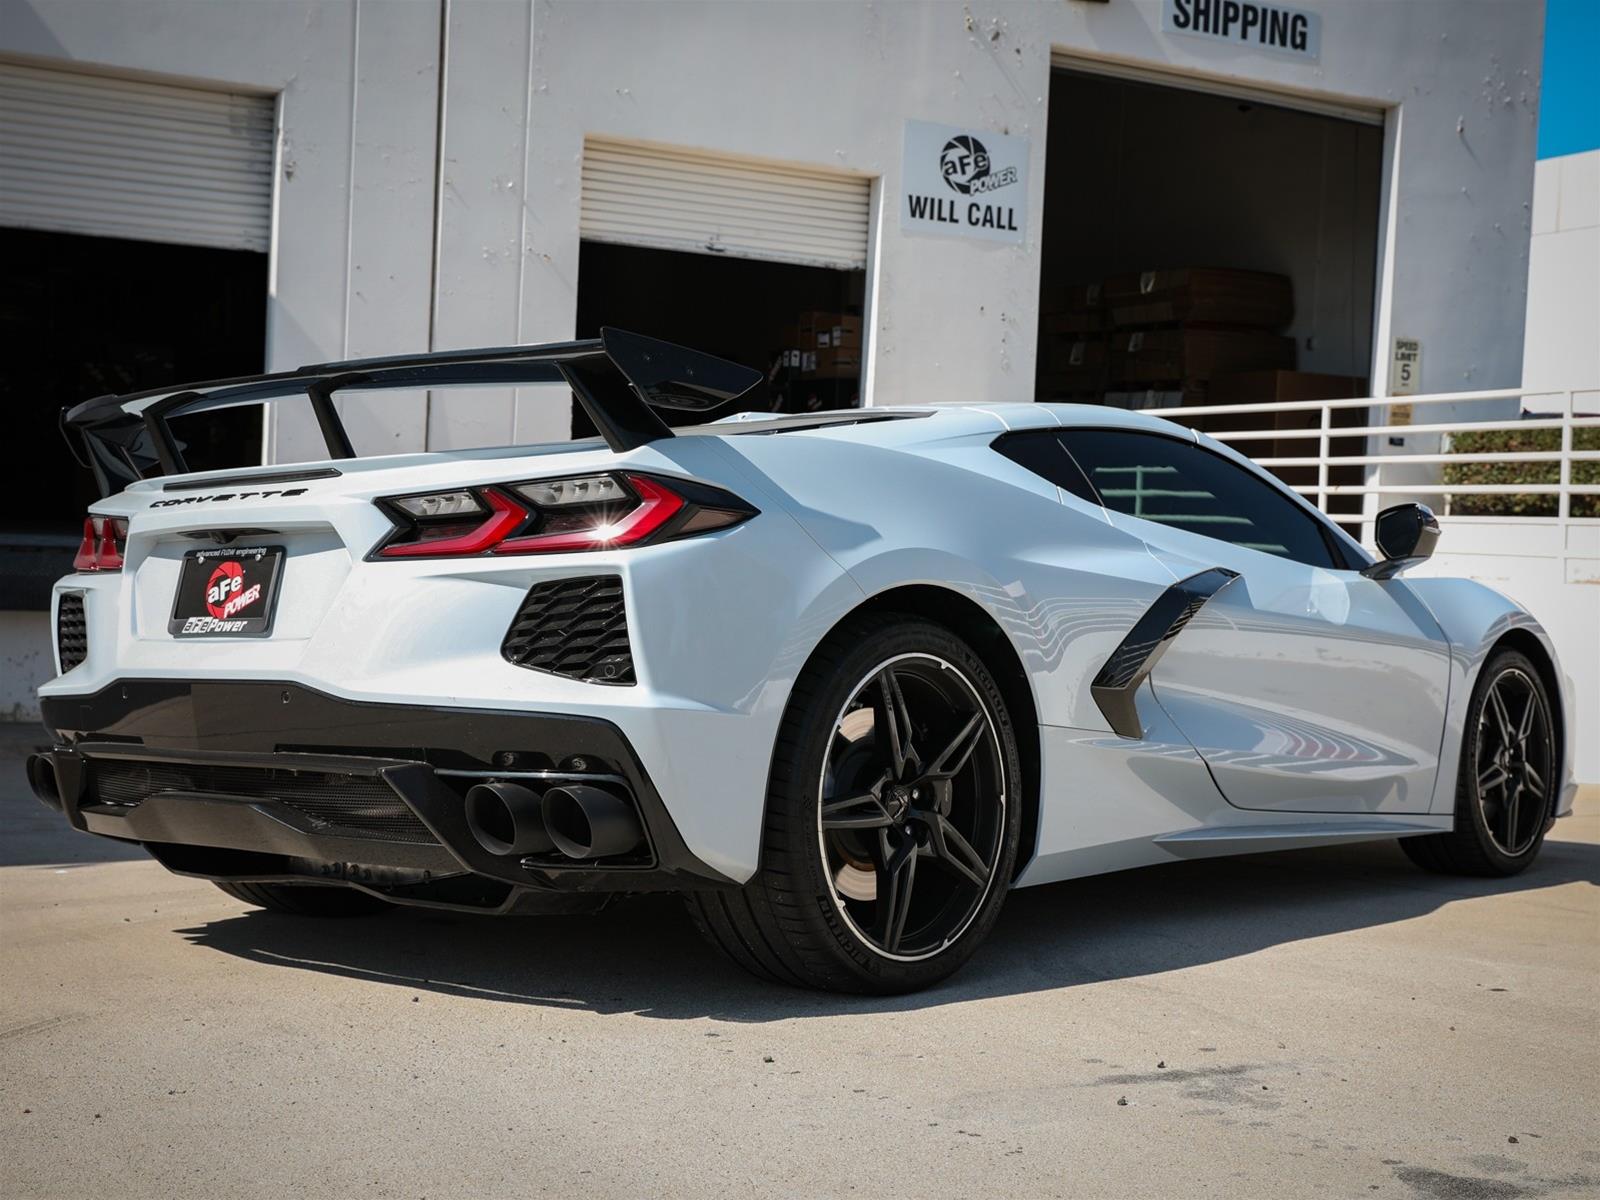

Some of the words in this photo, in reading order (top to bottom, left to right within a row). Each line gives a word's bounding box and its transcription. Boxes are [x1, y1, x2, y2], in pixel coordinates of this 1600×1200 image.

[1172, 0, 1308, 52] SHIPPING
[943, 152, 988, 177] aFe
[968, 166, 1018, 197] POWER
[908, 194, 960, 224] WILL
[967, 202, 1018, 231] CALL
[1394, 352, 1419, 362] LIMIT
[1395, 340, 1419, 352] SPEED
[1401, 363, 1411, 382] 5
[149, 488, 309, 509] CORVETTE
[196, 550, 221, 558] advanced
[236, 547, 267, 557] engineering
[208, 575, 242, 604] aFe
[223, 583, 261, 619] POWER
